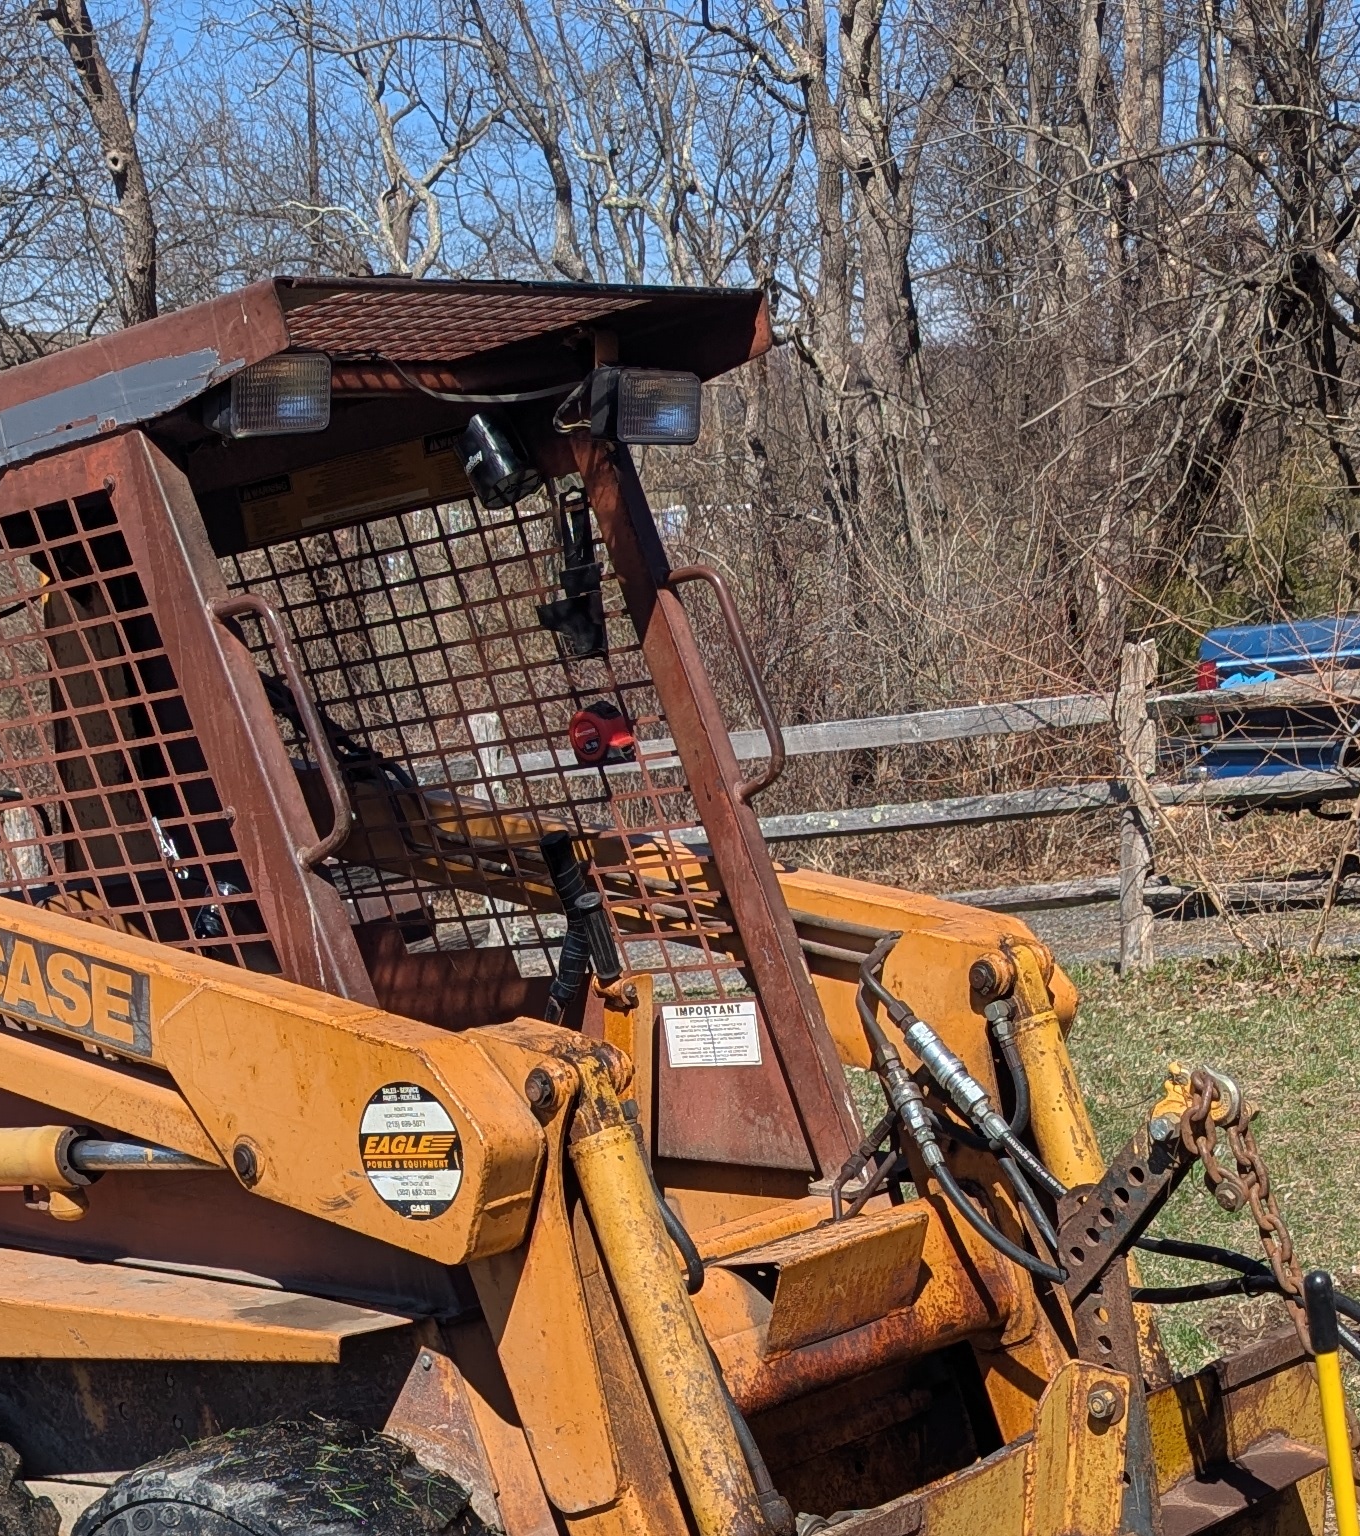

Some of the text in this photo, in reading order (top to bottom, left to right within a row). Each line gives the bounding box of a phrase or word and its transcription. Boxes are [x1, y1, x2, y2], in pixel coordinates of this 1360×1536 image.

[675, 1004, 741, 1016] IMPORTANT
[364, 1136, 433, 1154] EAGLE
[366, 1160, 392, 1169] POWER
[403, 1159, 449, 1169] EQUIPMENT
